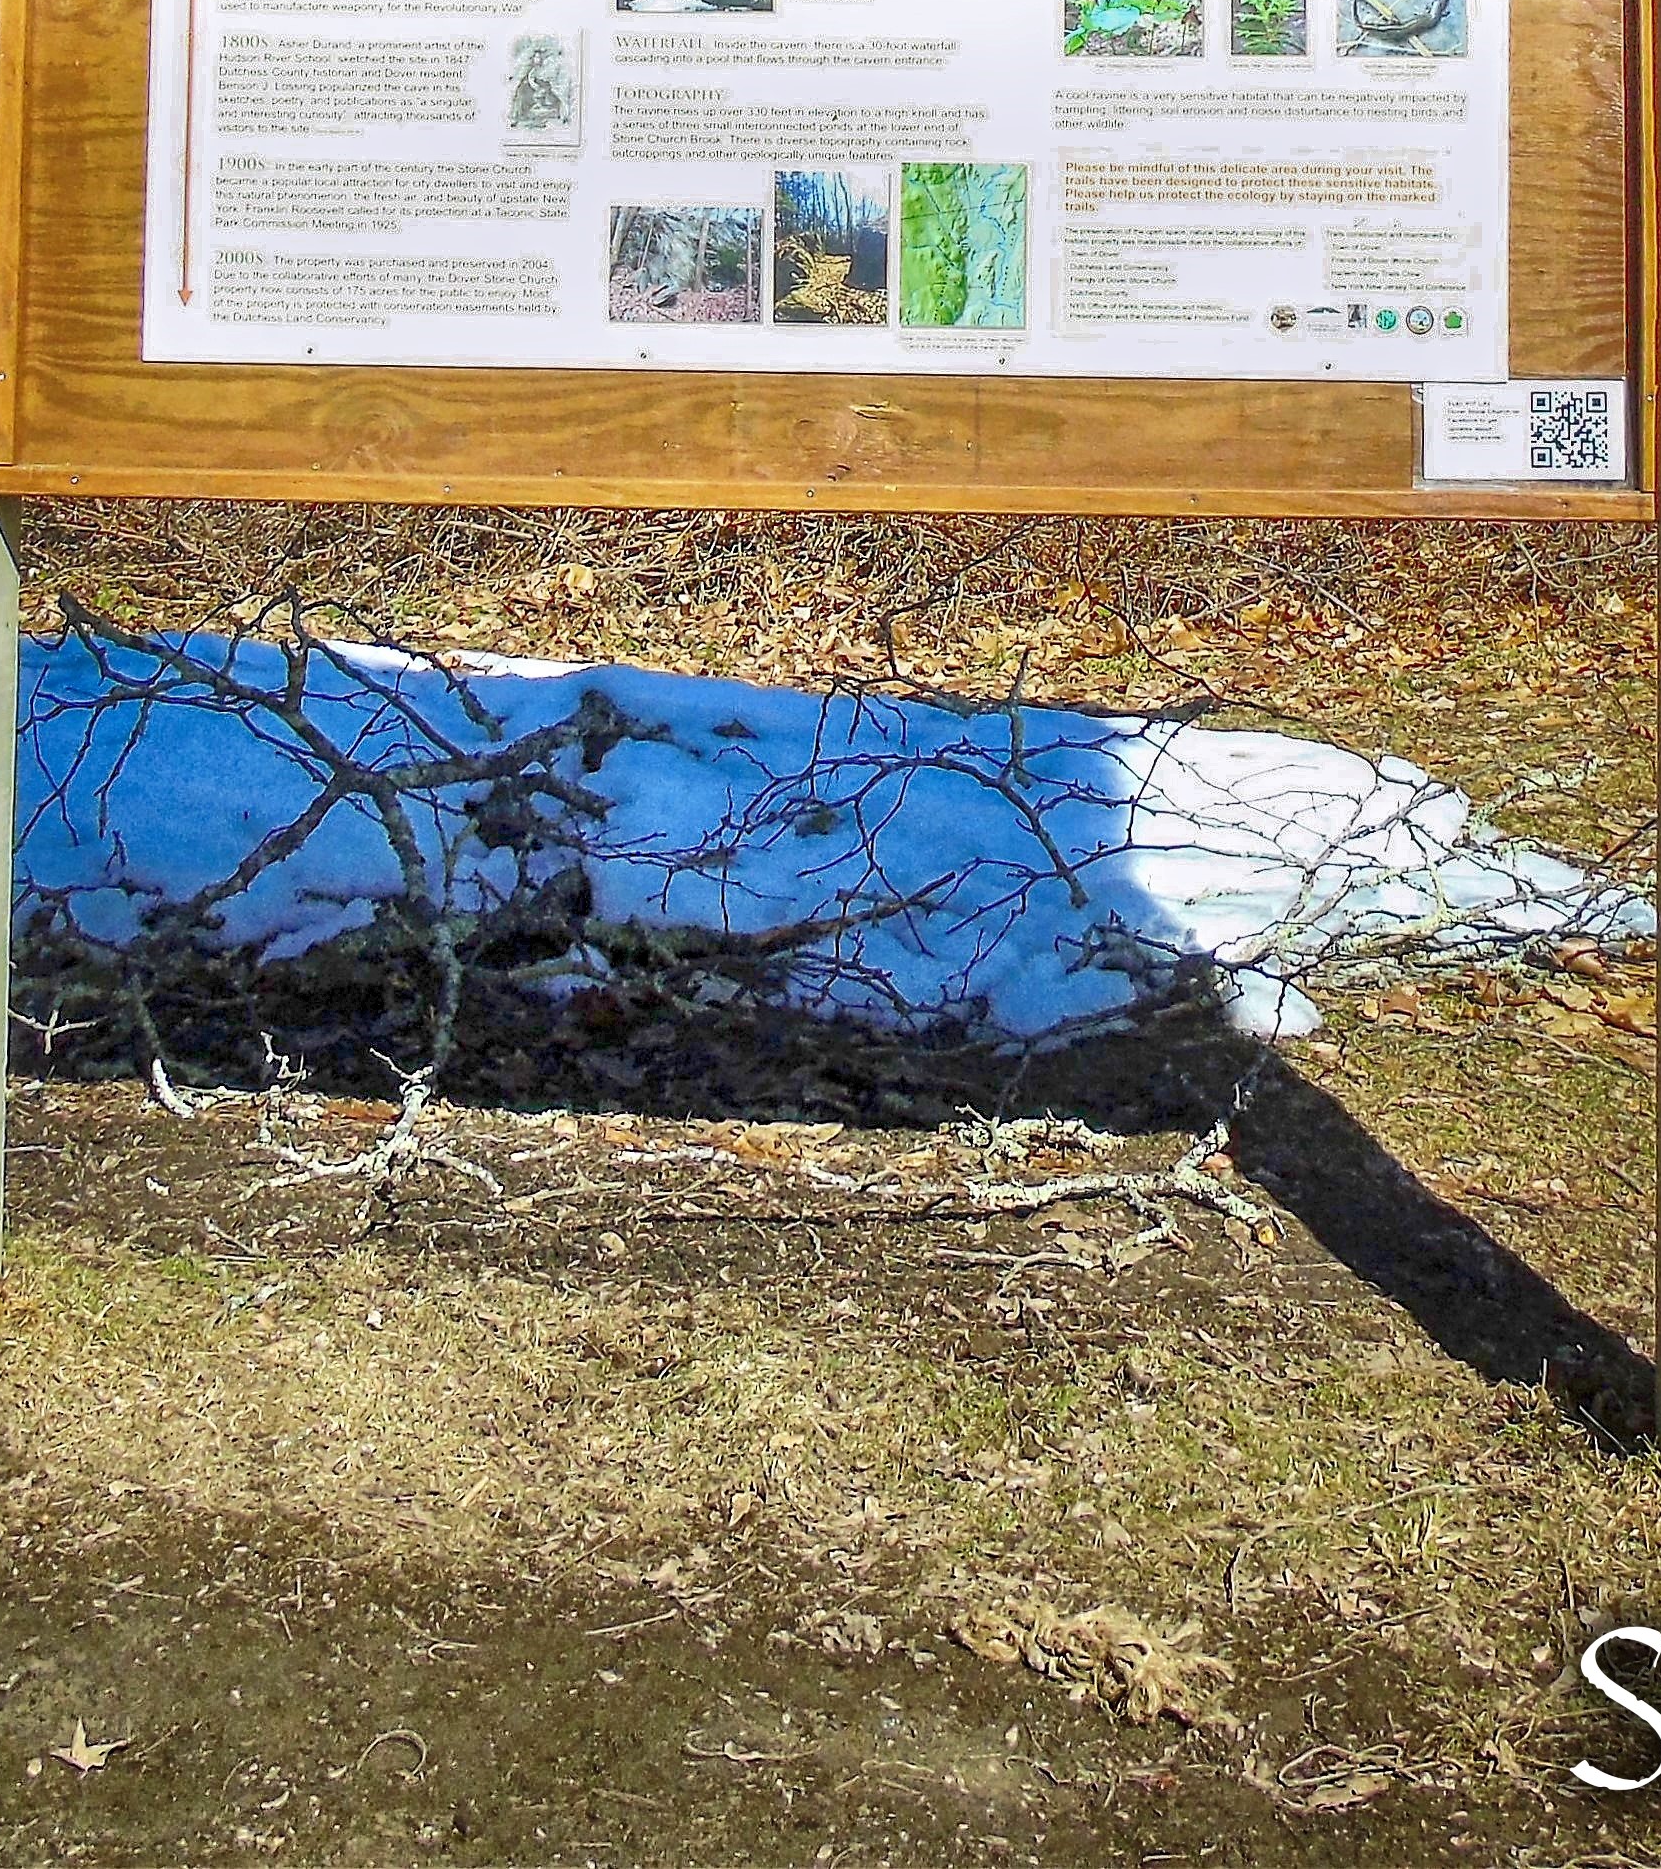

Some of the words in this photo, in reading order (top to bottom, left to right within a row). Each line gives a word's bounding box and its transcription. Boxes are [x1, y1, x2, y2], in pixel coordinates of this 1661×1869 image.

[1066, 162, 1106, 173] Please
[1110, 163, 1124, 173] be
[1128, 163, 1174, 174] mindful
[1178, 163, 1190, 174] of
[1194, 163, 1216, 174] this
[1220, 164, 1268, 174] delicate
[1270, 166, 1298, 175] area
[1302, 164, 1342, 177] during
[1344, 167, 1372, 178] your
[1410, 165, 1434, 176] The
[1066, 175, 1096, 186] trails
[1098, 175, 1128, 186] have
[1132, 175, 1162, 186] been
[1166, 176, 1222, 189] designed
[1226, 176, 1238, 187] to
[1240, 176, 1284, 190] protect
[1288, 177, 1322, 187] these
[1326, 177, 1382, 188] sensitive
[1066, 188, 1106, 199] Please
[1108, 189, 1136, 202] help
[1140, 191, 1154, 200] us
[1158, 189, 1202, 202] protect
[1204, 190, 1224, 200] the
[1228, 190, 1276, 203] ecology
[1280, 190, 1294, 203] by
[1298, 190, 1344, 204] staying
[1346, 193, 1362, 201] on
[1366, 191, 1386, 202] the
[1390, 191, 1436, 202] marked
